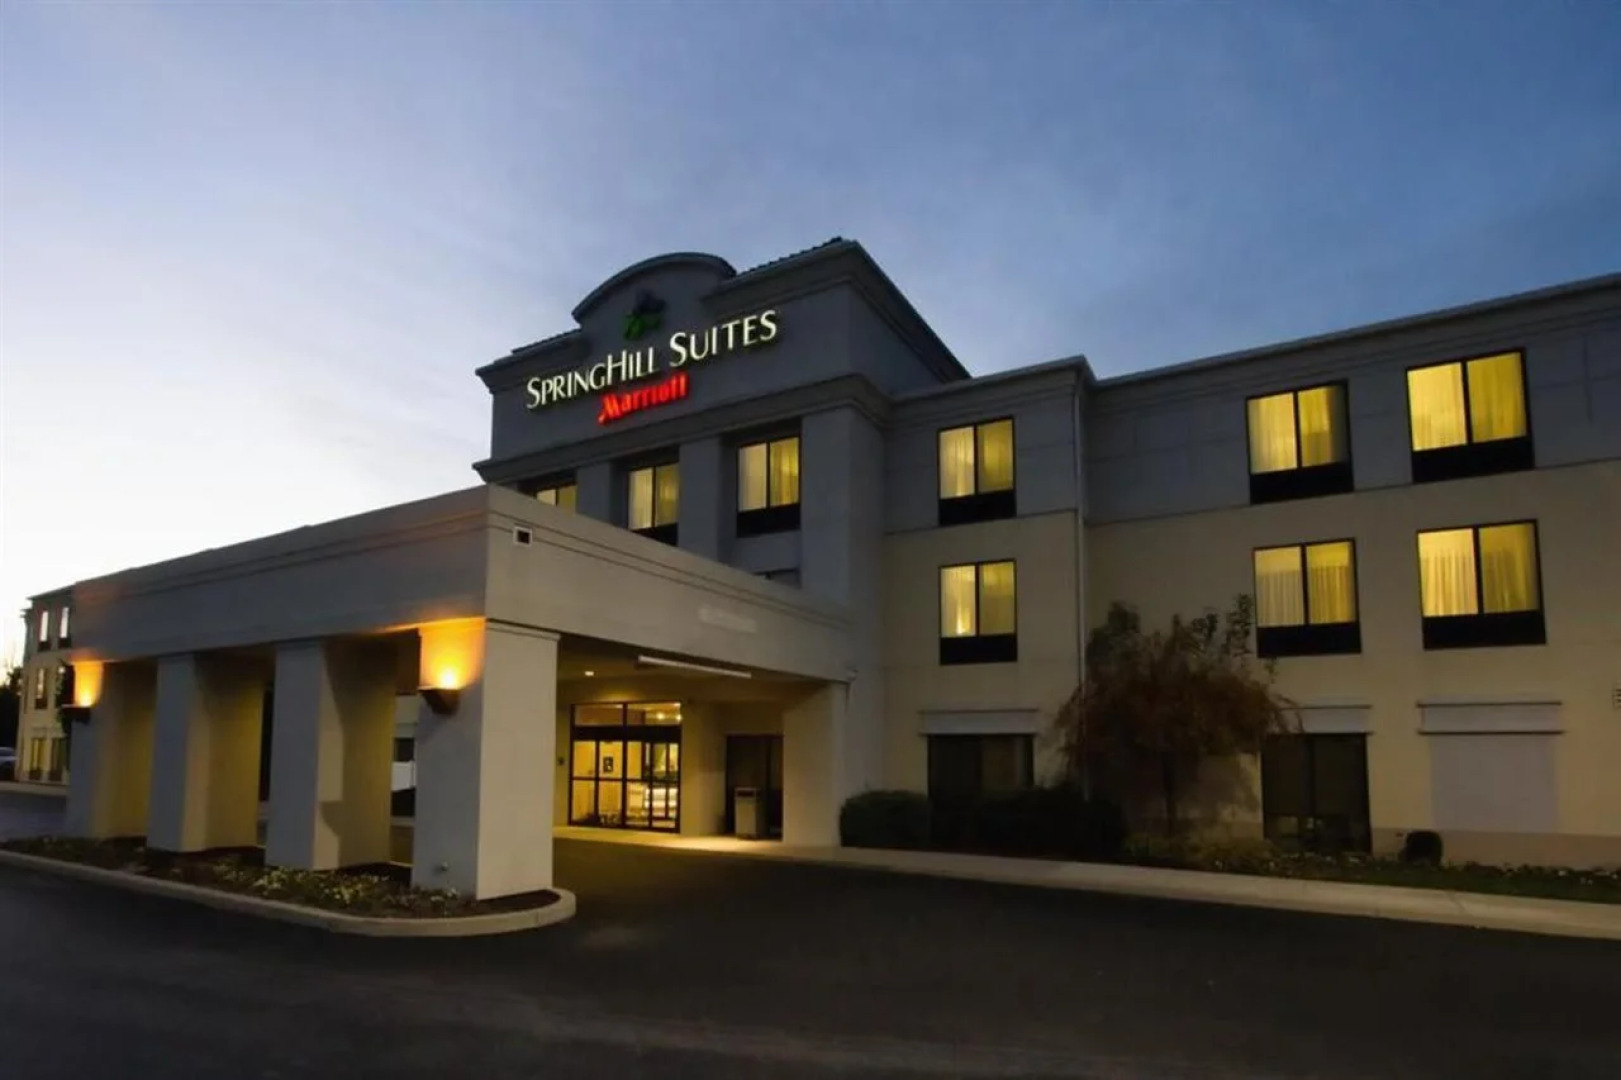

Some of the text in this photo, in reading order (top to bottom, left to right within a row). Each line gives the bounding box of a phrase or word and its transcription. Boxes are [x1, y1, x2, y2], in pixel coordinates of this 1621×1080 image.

[527, 310, 777, 409] SPRINGHILL SUITES
[598, 373, 689, 424] Marriott
